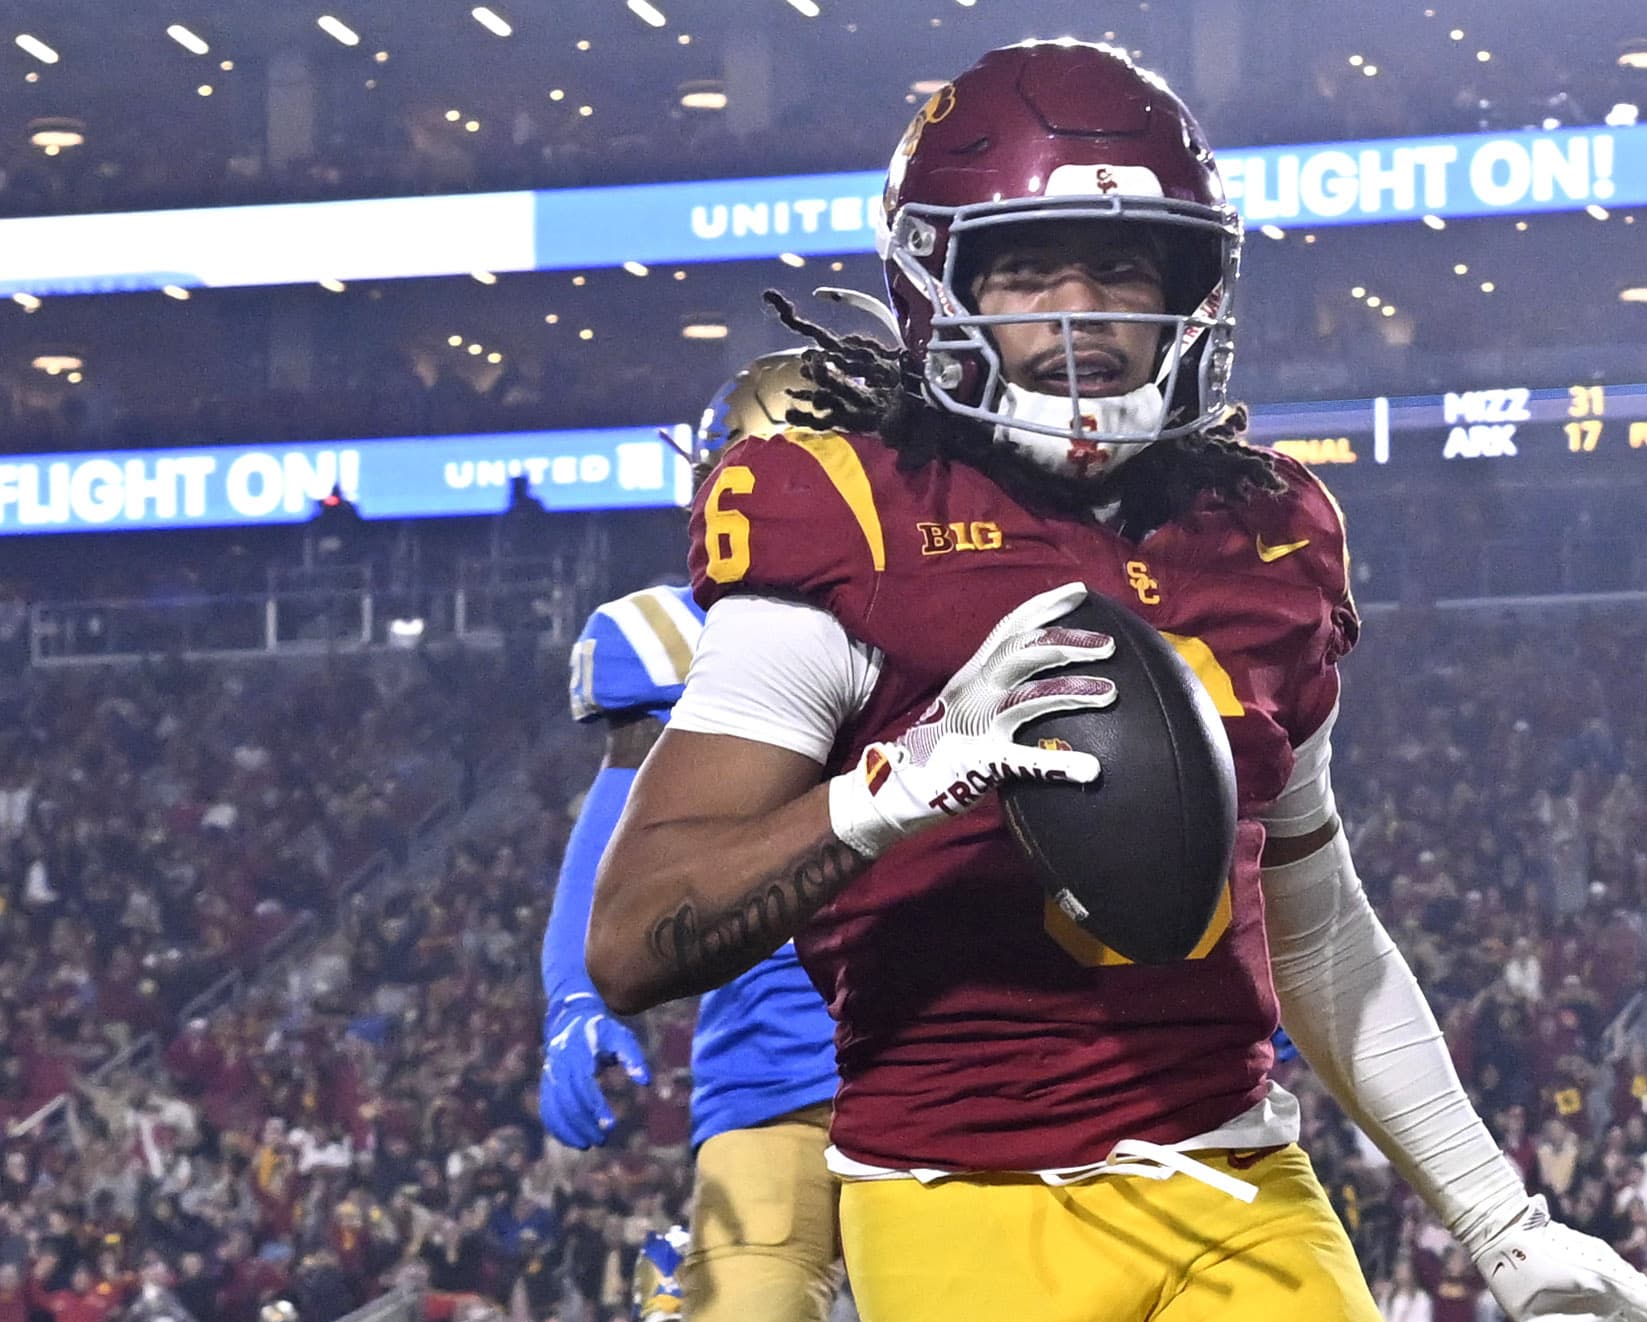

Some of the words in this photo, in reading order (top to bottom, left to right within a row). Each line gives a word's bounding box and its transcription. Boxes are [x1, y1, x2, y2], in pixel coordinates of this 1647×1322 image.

[1470, 135, 1615, 207] ON!
[1568, 386, 1604, 418] 31
[1443, 424, 1518, 459] ARK
[1564, 420, 1603, 452] 17
[444, 454, 611, 488] UNITED
[704, 465, 756, 584] 6
